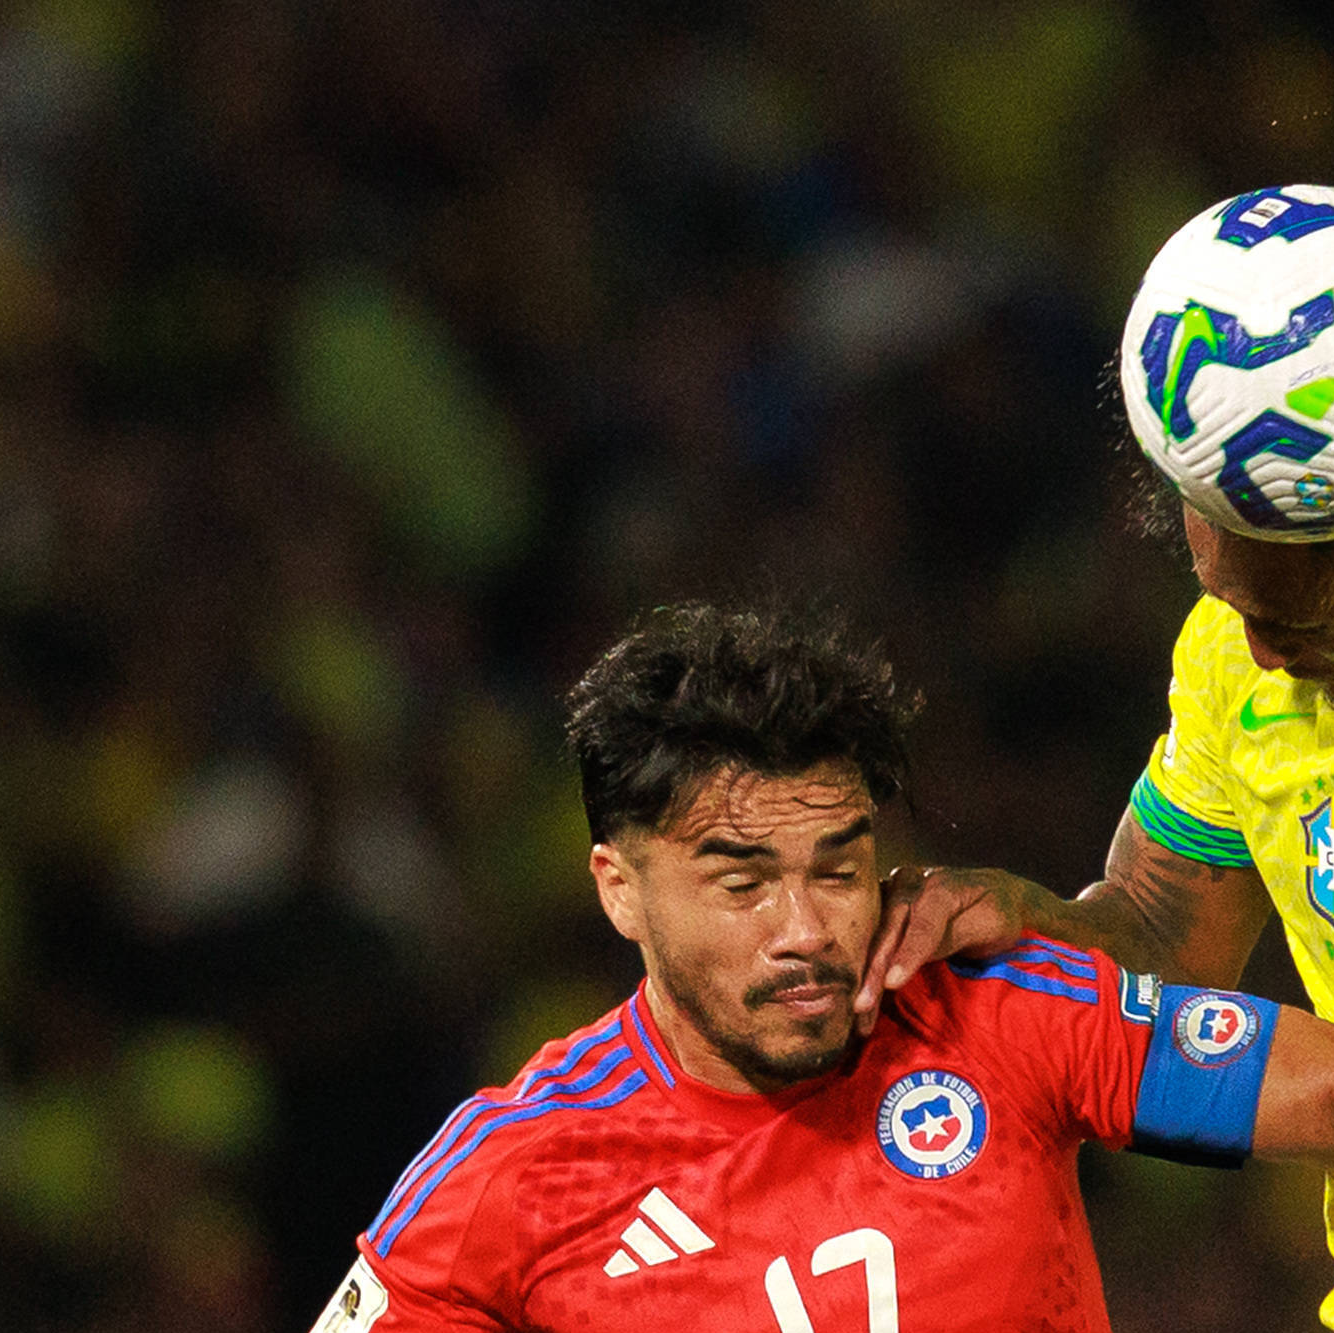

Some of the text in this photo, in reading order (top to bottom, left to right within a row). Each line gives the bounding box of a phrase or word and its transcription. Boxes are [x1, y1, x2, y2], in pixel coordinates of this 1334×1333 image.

[878, 1071, 981, 1145] FEDERACION DE FUTBOL
[923, 1150, 977, 1179] DE CHILE
